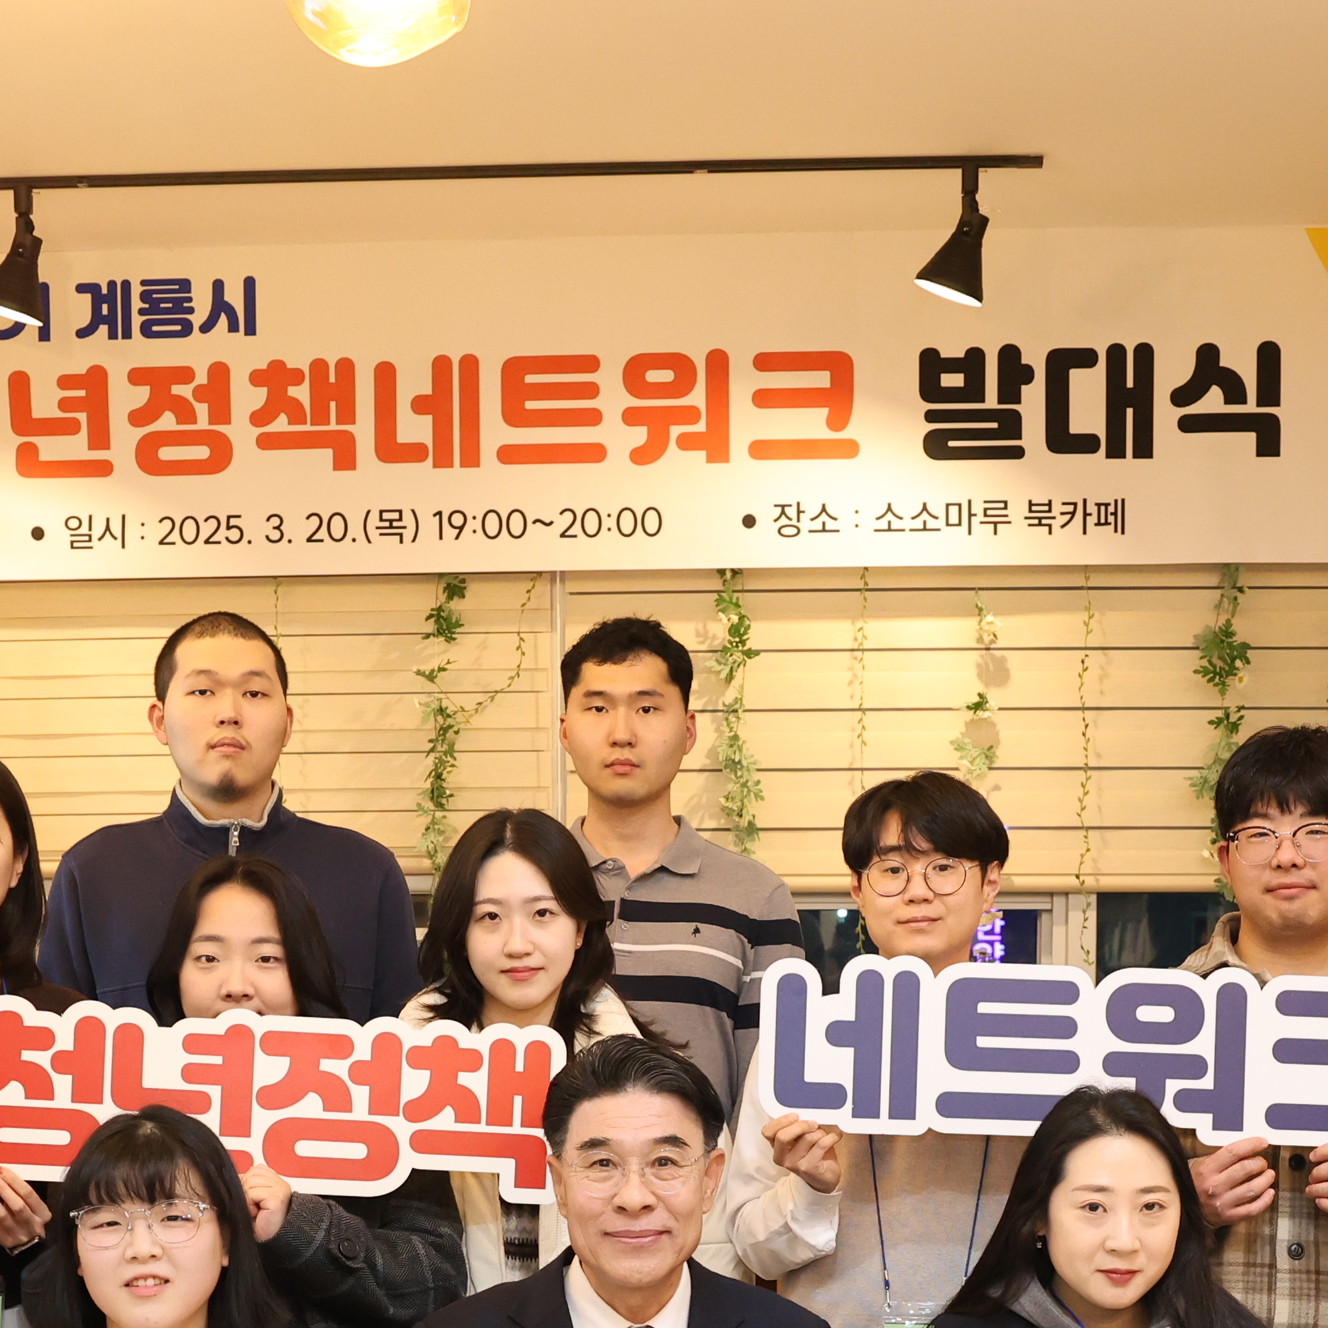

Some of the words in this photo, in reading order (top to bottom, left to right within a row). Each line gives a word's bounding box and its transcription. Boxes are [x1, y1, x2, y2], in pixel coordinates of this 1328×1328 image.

[75, 275, 257, 341] 계룡시
[917, 339, 1283, 462] 발대식
[63, 513, 127, 550] 일시
[157, 513, 253, 547] 2025.
[264, 512, 294, 545] 3.
[431, 505, 663, 542] 19:00~20:00
[772, 500, 841, 539] 장소
[872, 498, 1013, 537] 소소마루
[1022, 496, 1127, 537] 북카페
